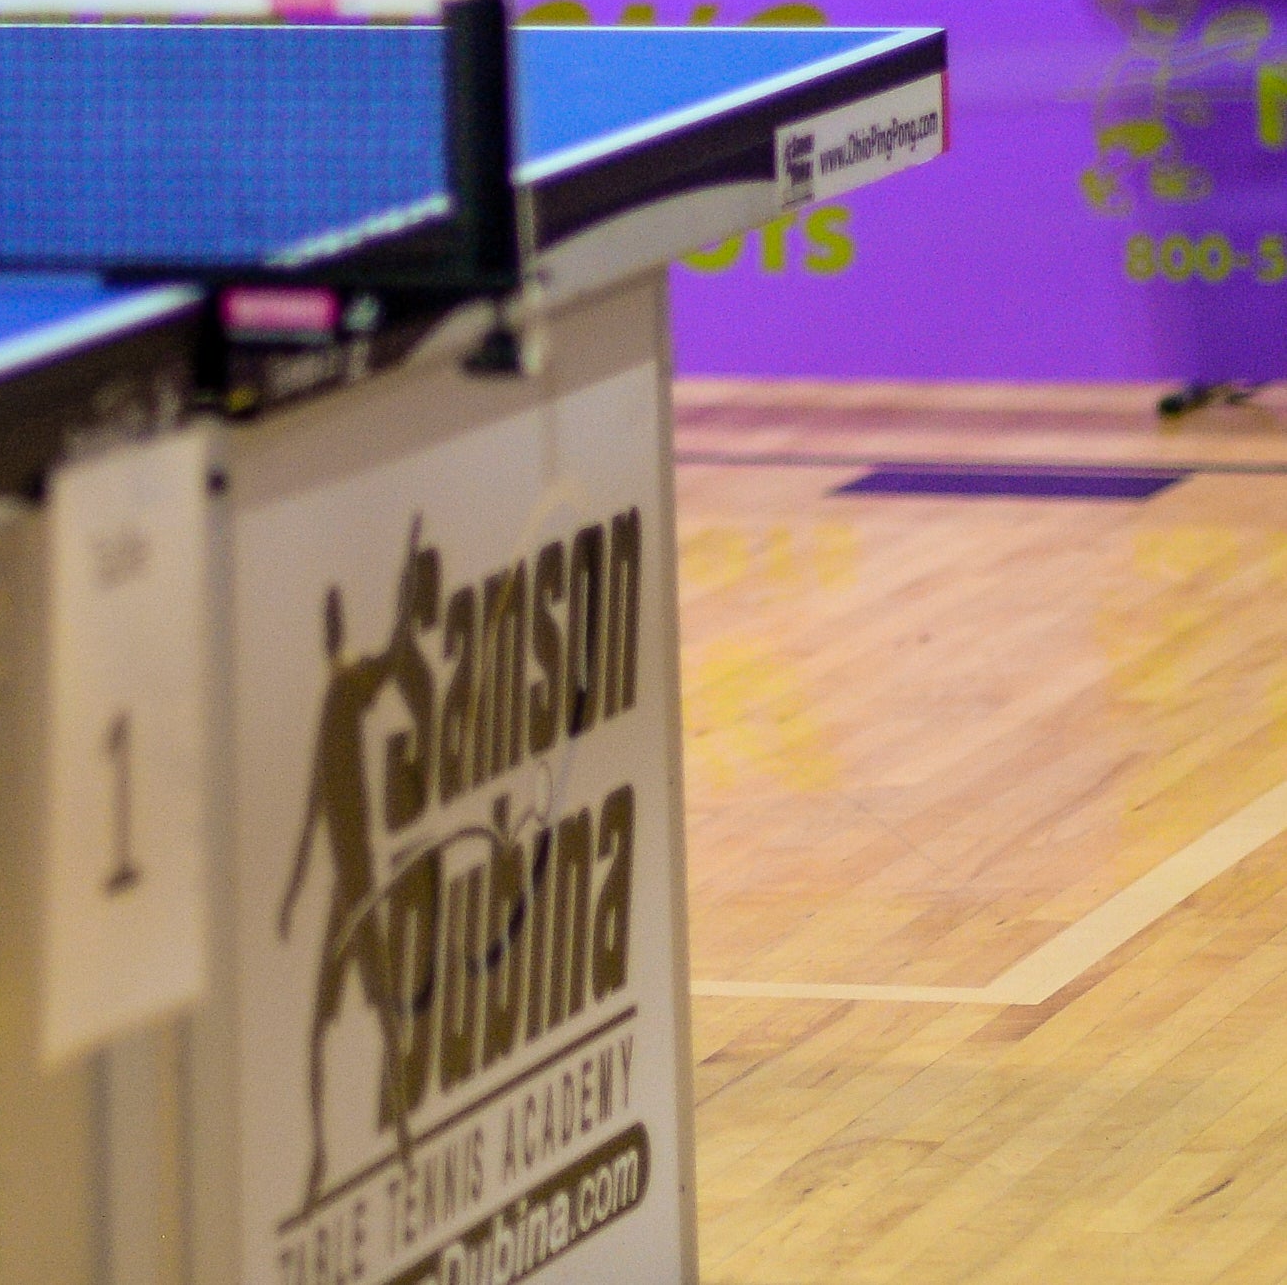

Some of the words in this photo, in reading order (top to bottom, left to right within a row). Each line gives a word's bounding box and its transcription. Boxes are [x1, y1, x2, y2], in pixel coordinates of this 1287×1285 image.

[382, 507, 643, 835] Samson
[376, 783, 638, 1133] Dubina
[386, 1123, 486, 1261] TENNIS
[503, 1035, 634, 1187] ACADEMY
